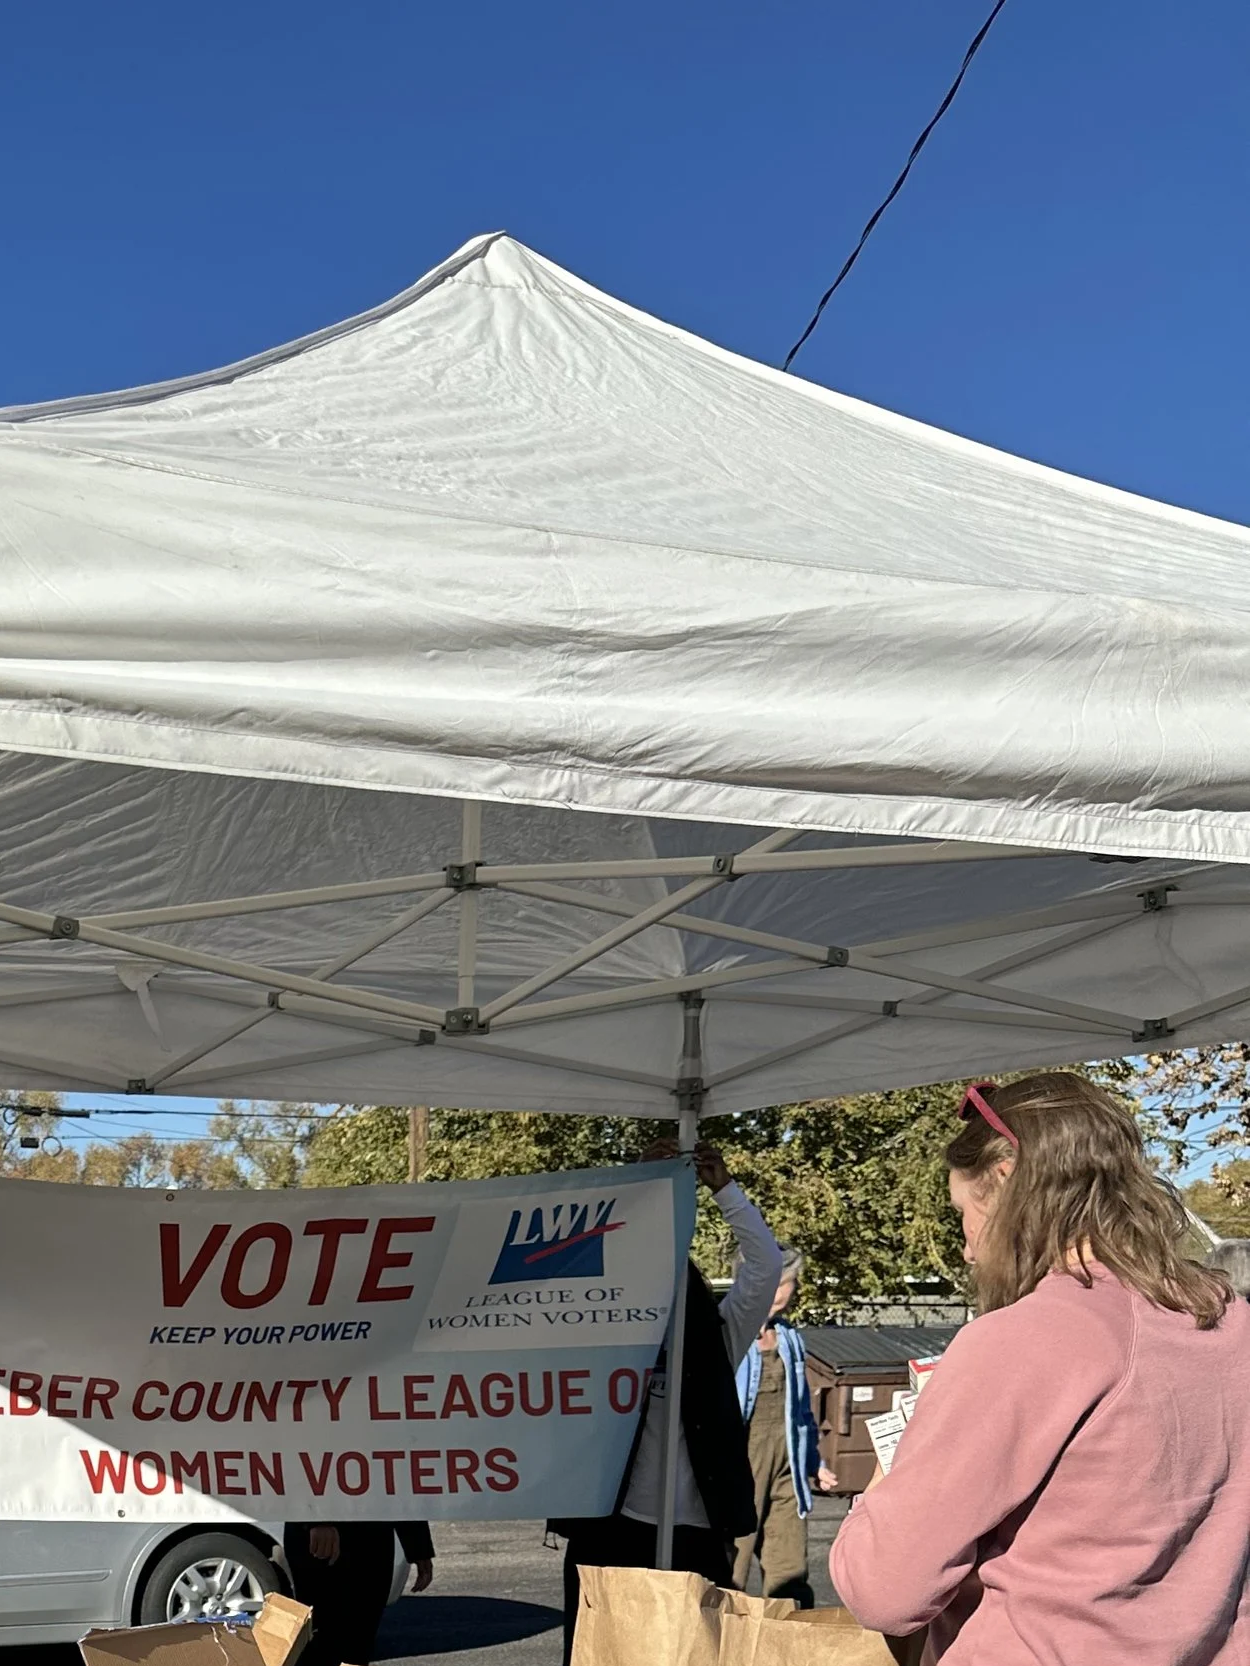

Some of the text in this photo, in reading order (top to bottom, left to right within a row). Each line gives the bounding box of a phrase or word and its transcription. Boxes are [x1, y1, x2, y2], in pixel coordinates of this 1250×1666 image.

[159, 1216, 436, 1309] VOTE
[465, 1287, 624, 1309] LEAGUE OF
[149, 1320, 372, 1345] KEEP YOUR POWER
[428, 1313, 532, 1330] WOMEN
[131, 1375, 353, 1423] COUNTY
[368, 1367, 593, 1421] LEAGUE
[79, 1447, 520, 1496] WOMEN VOTERS
